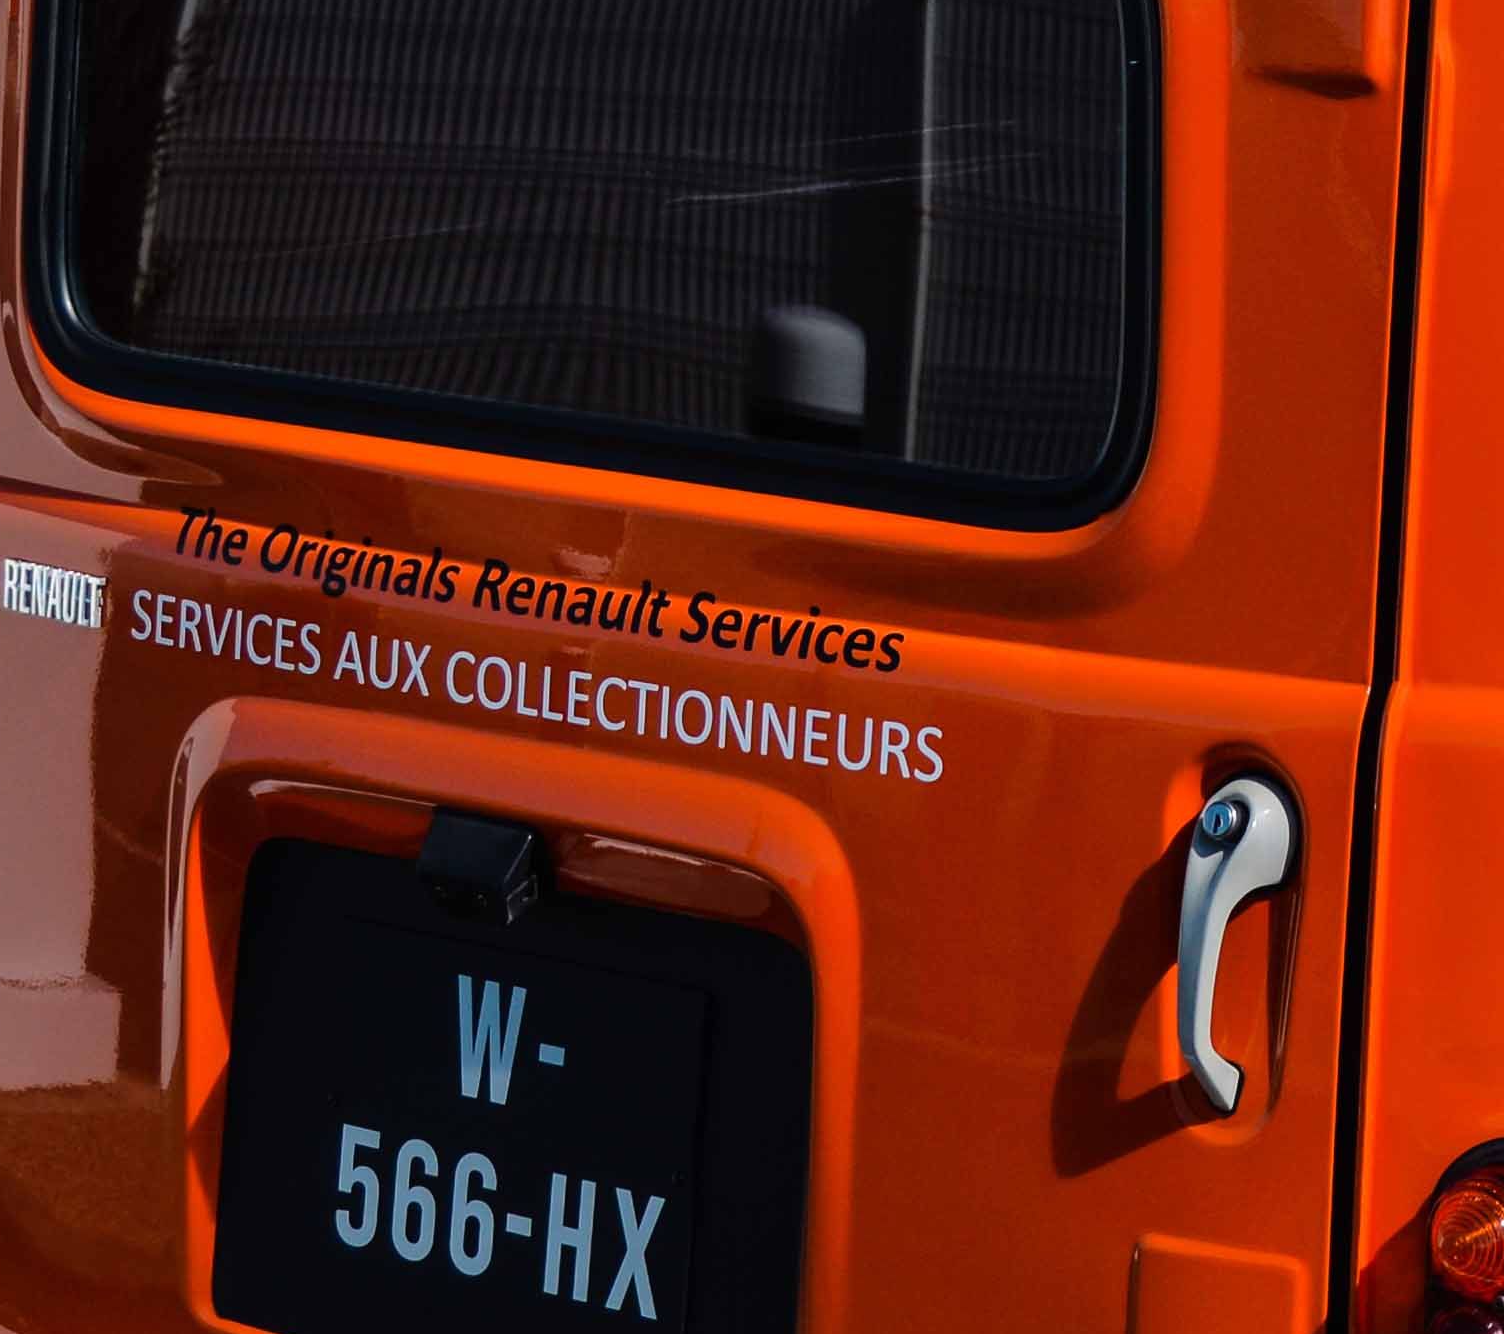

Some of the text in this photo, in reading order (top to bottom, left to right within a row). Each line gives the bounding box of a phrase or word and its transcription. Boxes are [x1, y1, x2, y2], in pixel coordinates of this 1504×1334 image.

[3, 557, 107, 629] RENAULT
[177, 506, 906, 673] The Originals Renault Services
[130, 588, 945, 784] SERVICES AUX COLLECTIONNEURS
[457, 973, 566, 1105] W-
[334, 1122, 666, 1320] 566-HX
